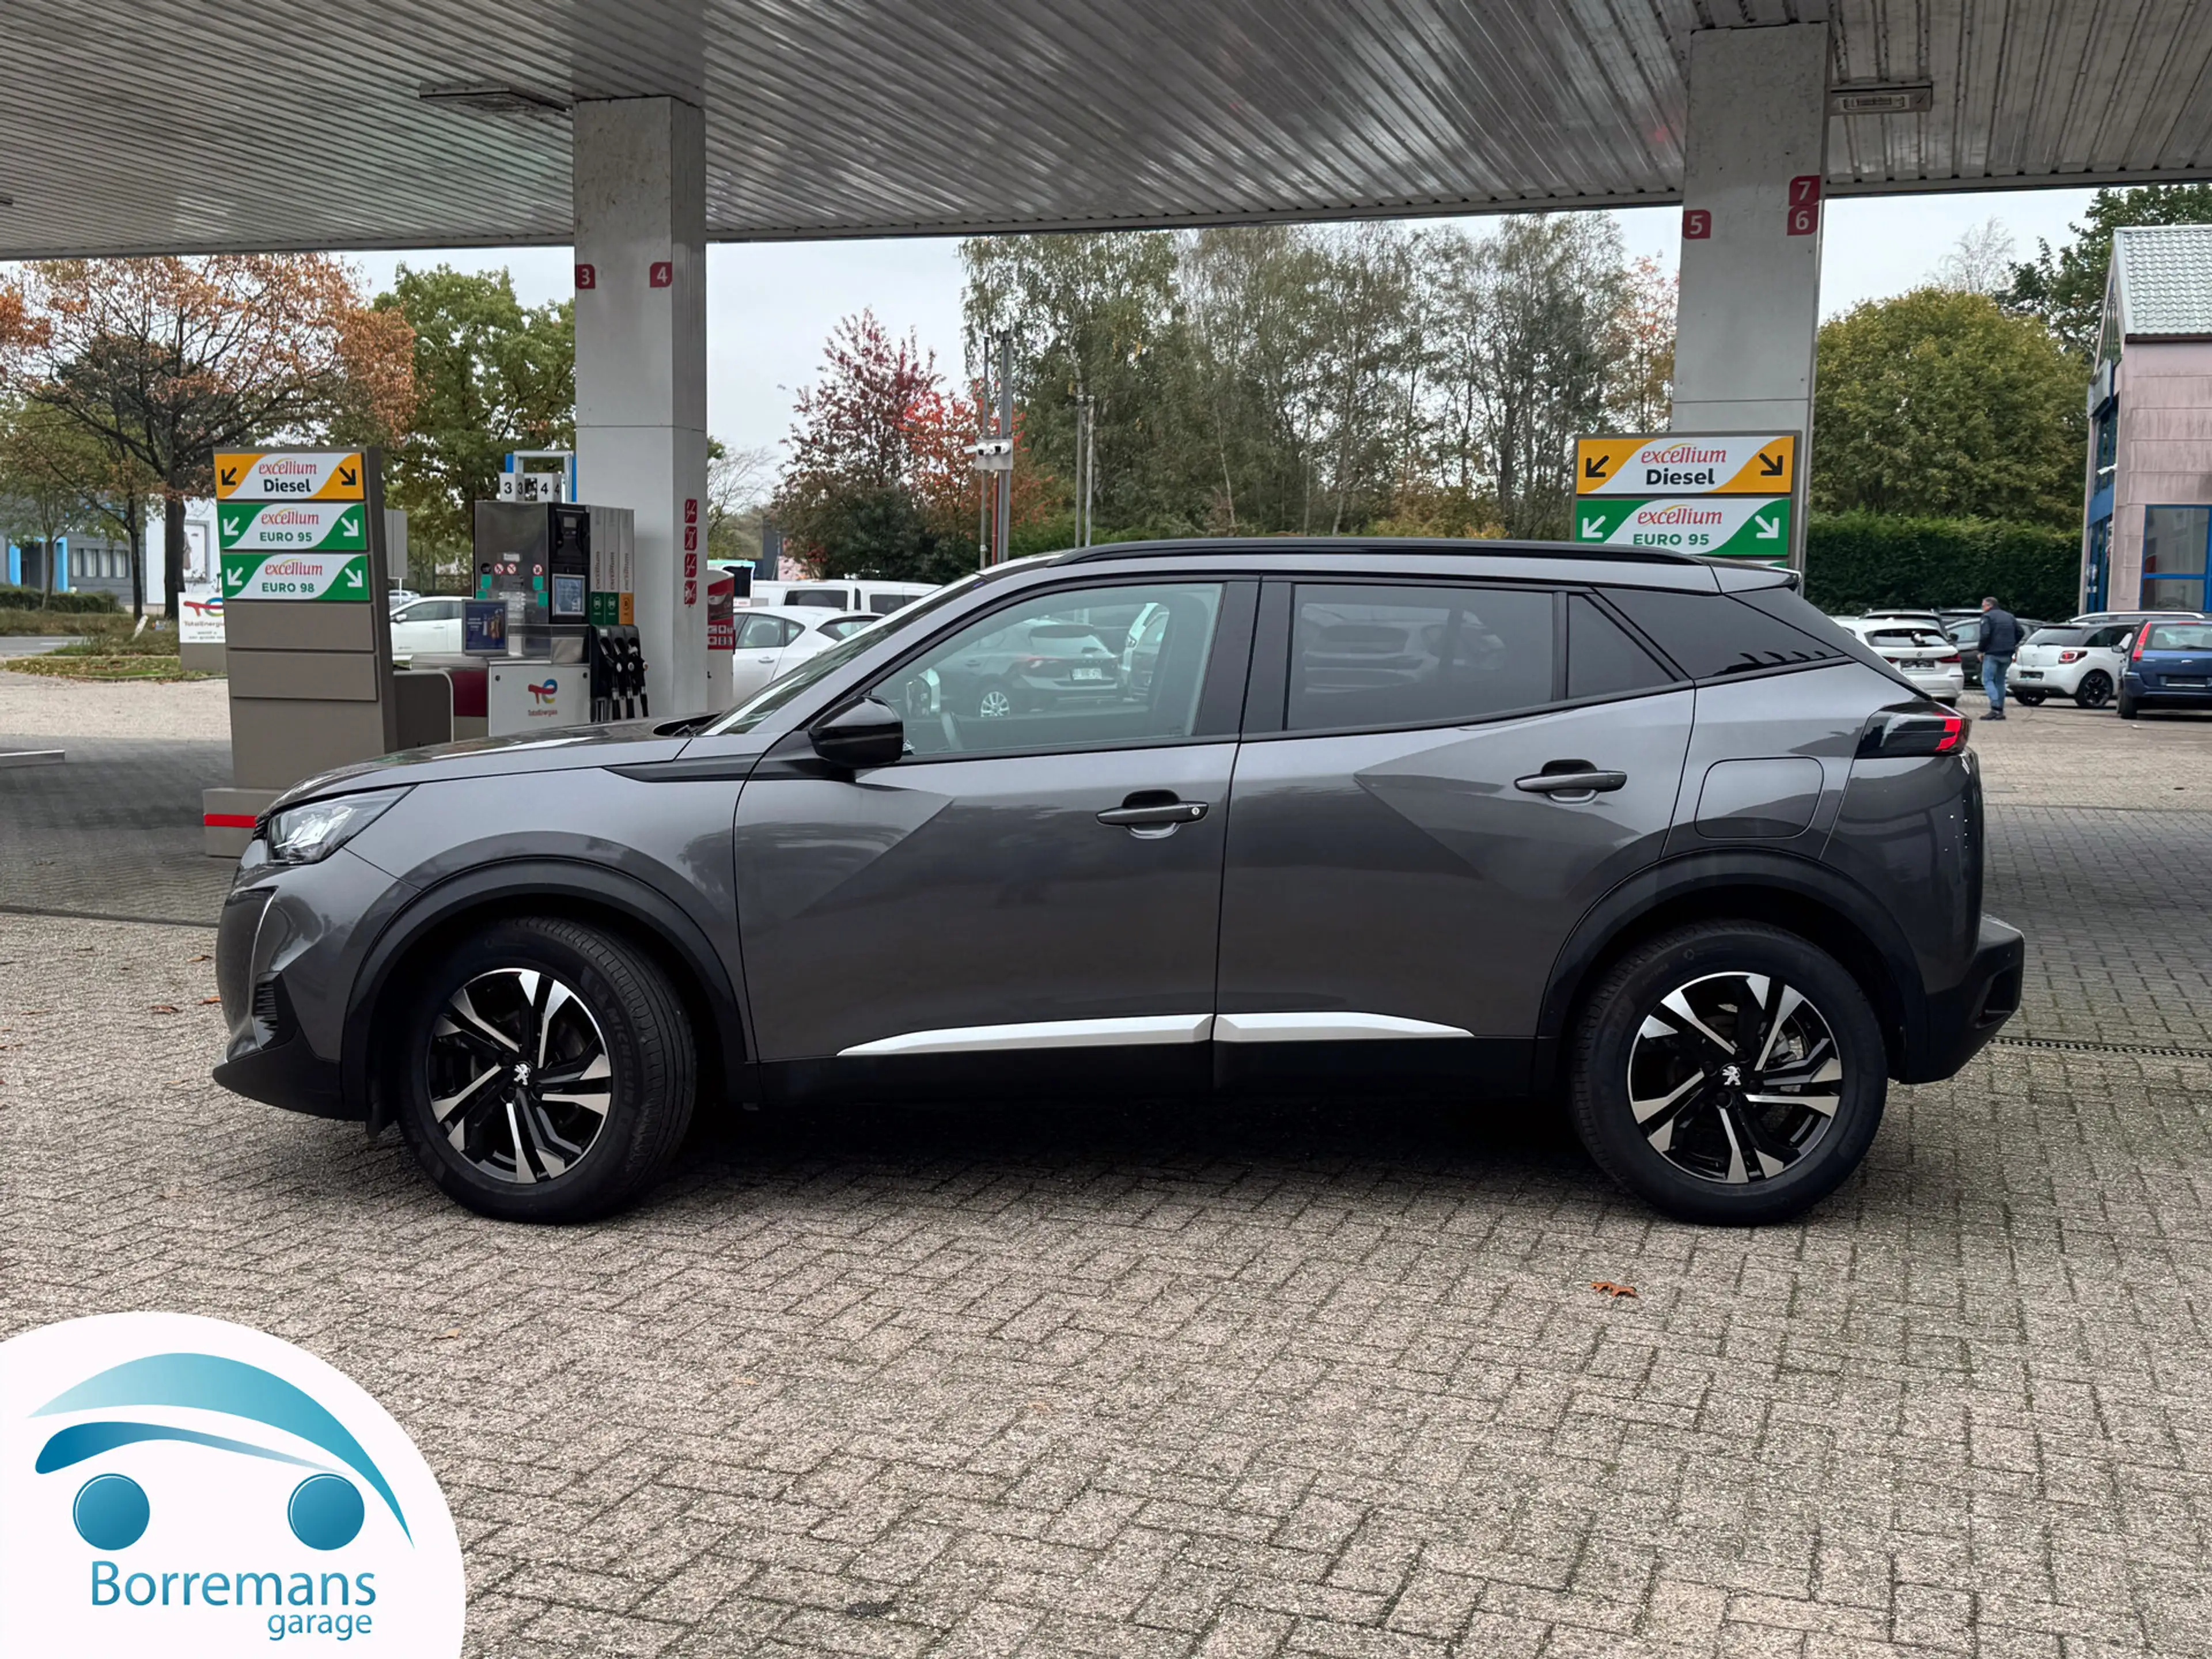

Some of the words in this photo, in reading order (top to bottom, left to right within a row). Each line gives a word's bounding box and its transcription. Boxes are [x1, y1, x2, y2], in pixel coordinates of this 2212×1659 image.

[1797, 181, 1812, 200] 7
[1690, 215, 1703, 235] 5
[1796, 210, 1809, 230] 6
[581, 269, 590, 285] 3
[657, 267, 667, 283] 4
[1641, 446, 1727, 464] excellium
[259, 460, 317, 475] excellium
[1646, 468, 1715, 485] Diesel
[263, 479, 312, 493] Diesel
[504, 482, 512, 494] 3
[518, 482, 523, 495] 3
[540, 482, 548, 495] 4
[554, 483, 560, 495] 4
[261, 511, 319, 525] excellium
[1637, 507, 1722, 525] excellium
[259, 532, 294, 542] EURO
[297, 532, 312, 542] 95
[1633, 533, 1682, 546] EURO
[1688, 533, 1709, 546] 95
[265, 562, 323, 576] excellium
[262, 582, 296, 593] EURO
[300, 582, 315, 593] 98
[605, 1007, 635, 1105] MICHELIN
